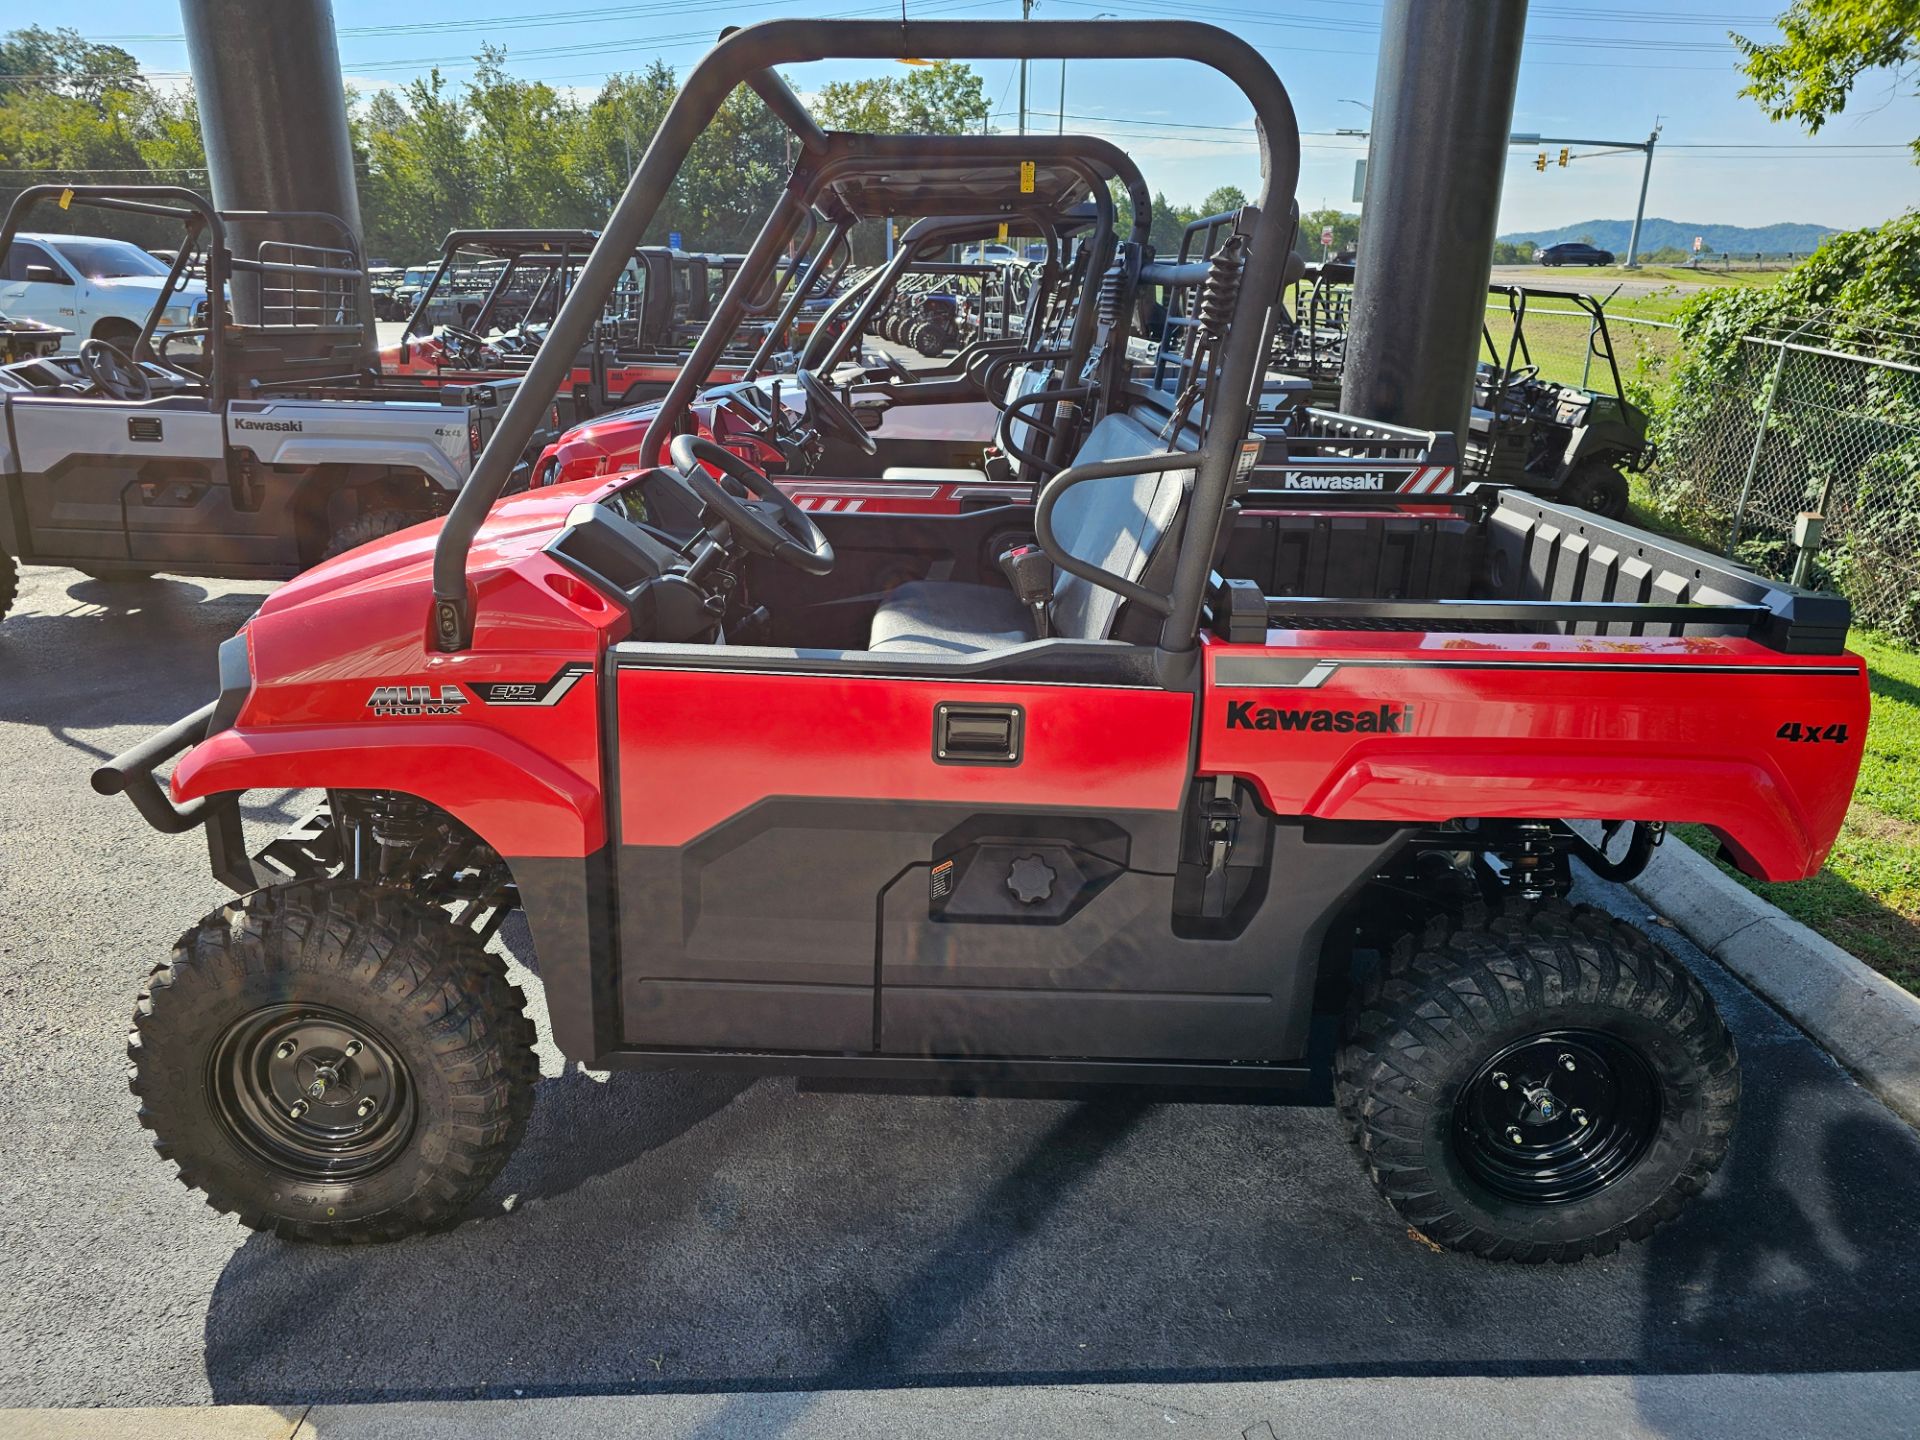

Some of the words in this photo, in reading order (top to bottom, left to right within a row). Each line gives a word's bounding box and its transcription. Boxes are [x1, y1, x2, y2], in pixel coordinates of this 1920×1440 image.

[234, 418, 303, 432] Kawasaki
[435, 428, 462, 437] 4x4
[1284, 472, 1384, 490] Kawasaki
[366, 685, 470, 707] MULE
[1226, 701, 1415, 733] Kawasaki
[1776, 722, 1849, 744] 4x4
